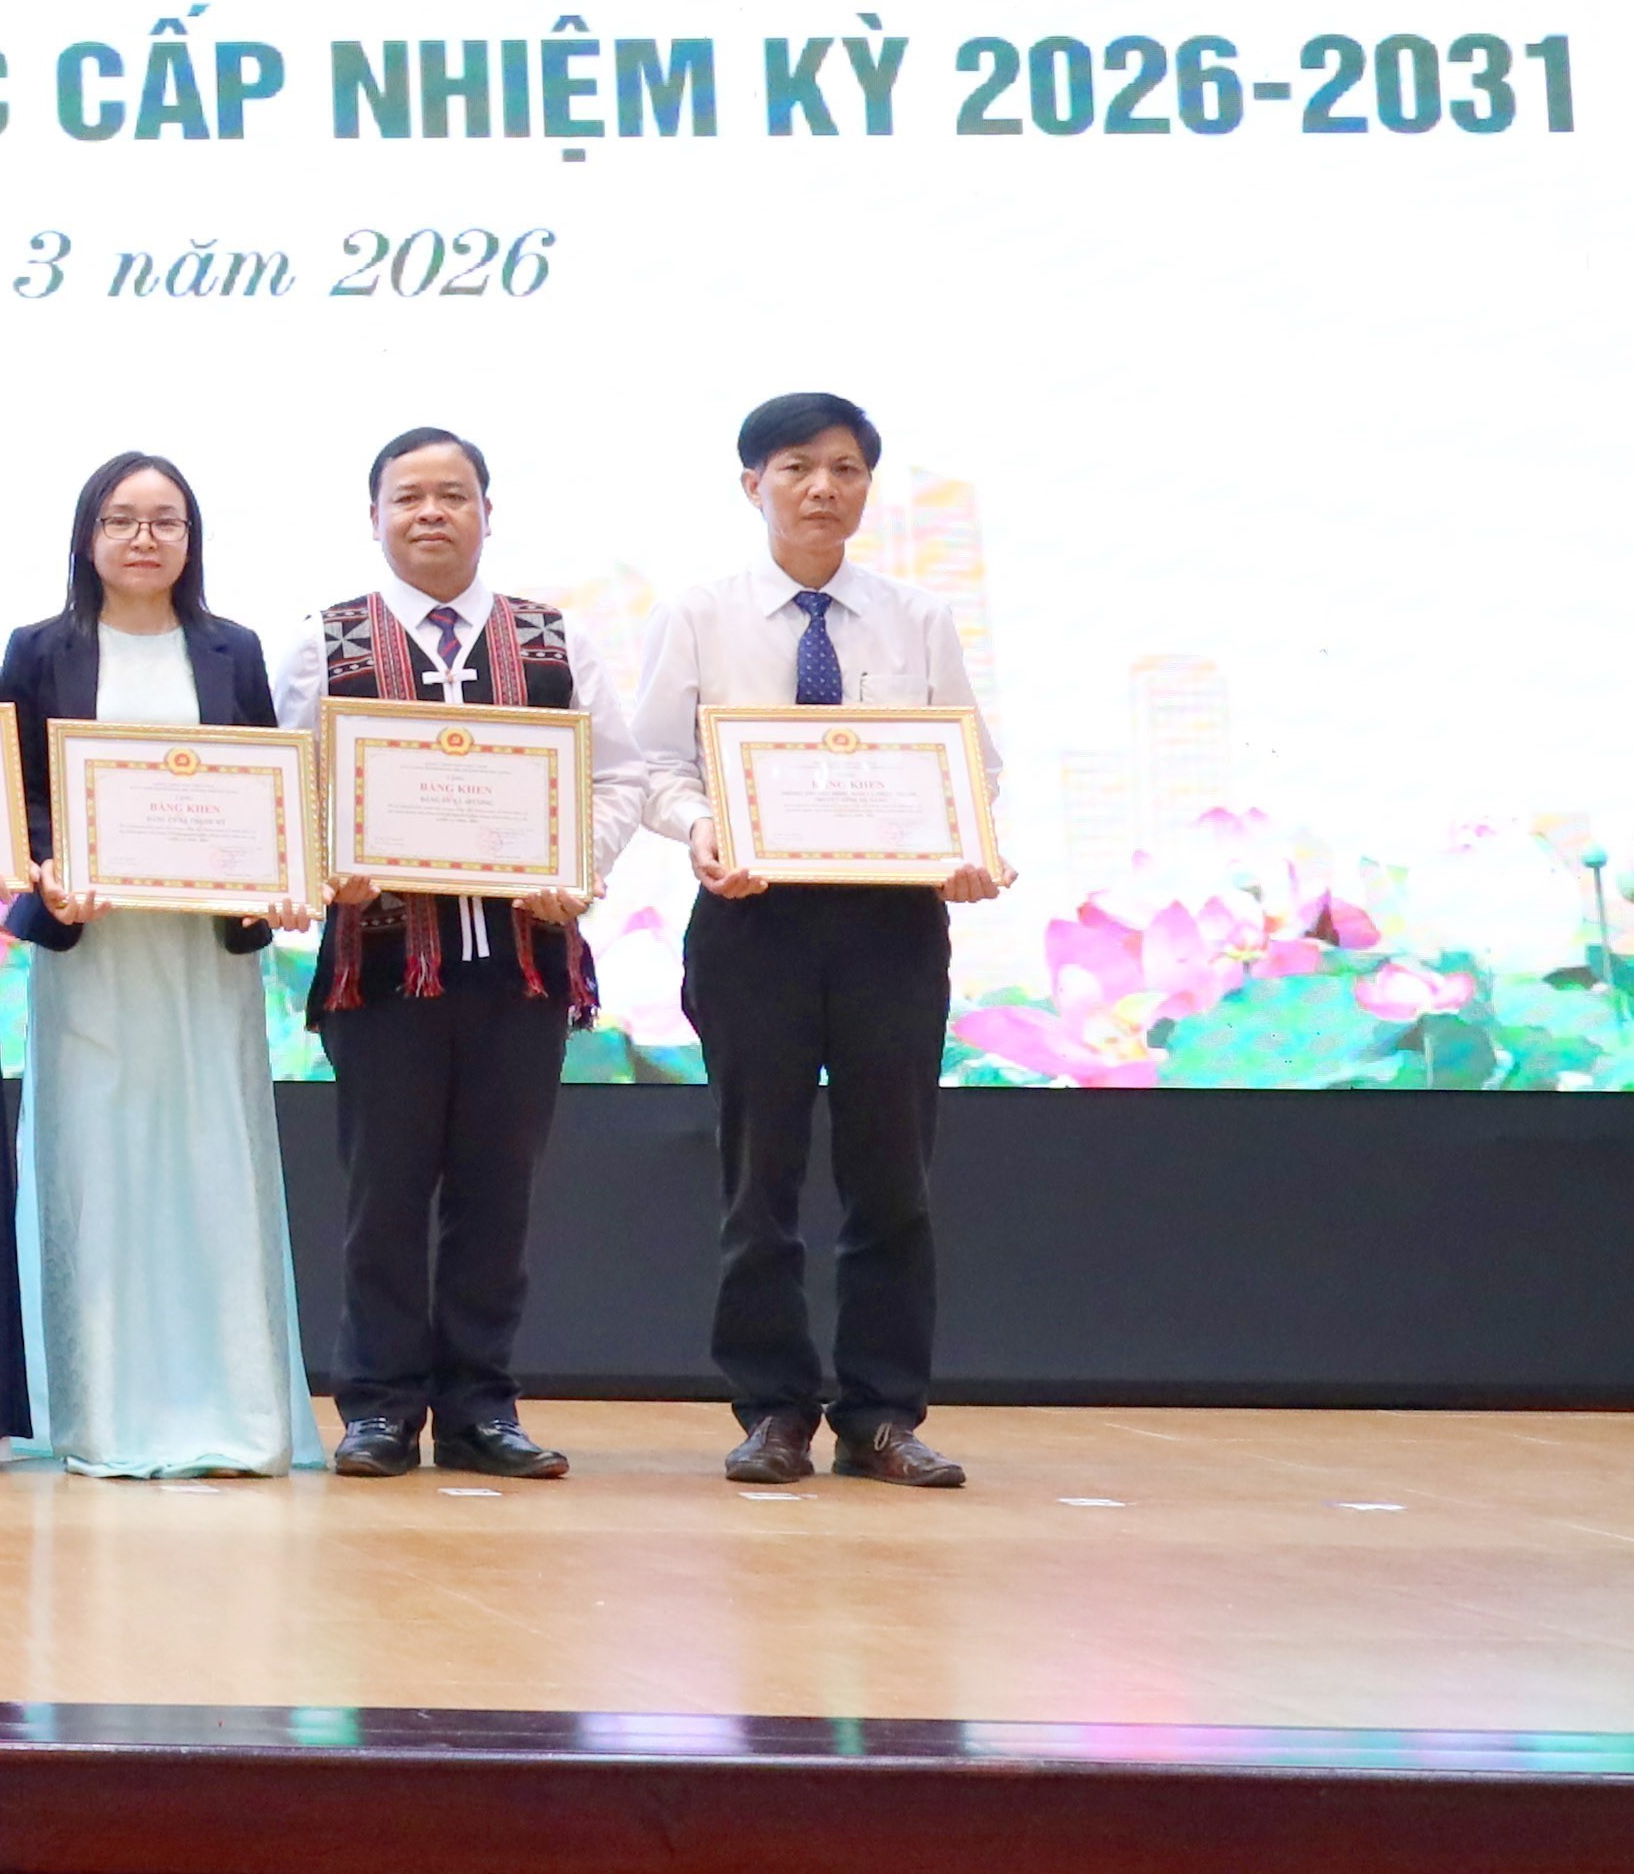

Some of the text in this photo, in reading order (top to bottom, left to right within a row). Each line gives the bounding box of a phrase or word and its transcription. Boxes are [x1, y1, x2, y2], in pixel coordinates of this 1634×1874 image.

[56, 4, 285, 141] CẤP
[331, 15, 717, 162] NHIỆM
[764, 13, 909, 136] KỲ
[956, 33, 1574, 136] 2026-2031
[13, 230, 71, 298] 3
[108, 239, 296, 297] năm
[328, 228, 557, 297] 2026
